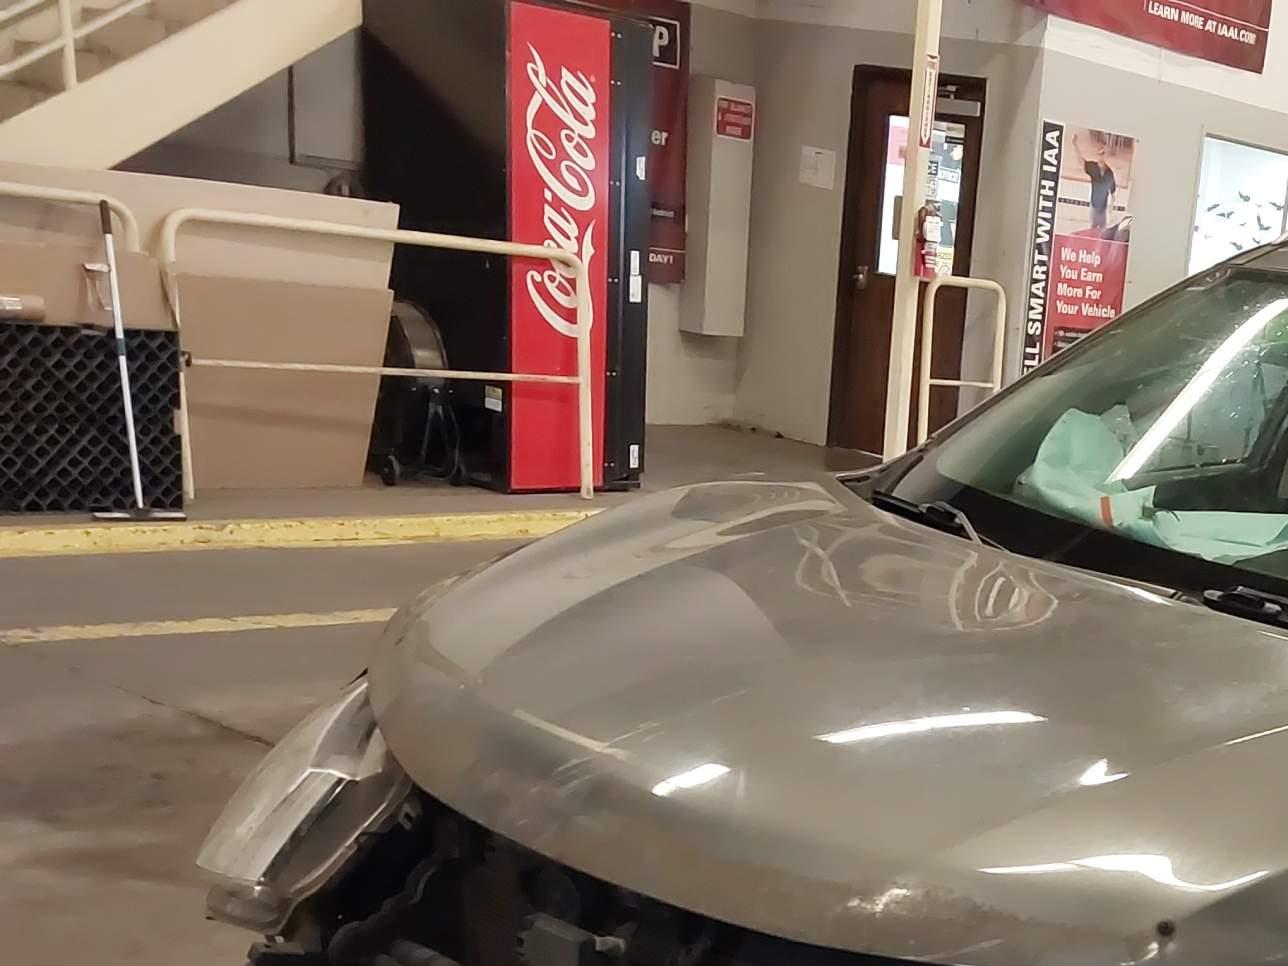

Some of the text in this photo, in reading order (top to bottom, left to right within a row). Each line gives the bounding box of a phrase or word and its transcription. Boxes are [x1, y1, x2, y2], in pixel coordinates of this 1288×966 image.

[1148, 1, 1257, 45] LEARN MORE AT IAAI.COM
[1042, 130, 1061, 178] IAA
[1034, 179, 1056, 243] WITH
[1061, 247, 1101, 266] We Help
[1060, 265, 1103, 282] You Earn
[1027, 250, 1050, 336] SMART
[1057, 283, 1101, 299] More For
[1056, 300, 1116, 318] Your Vehicle
